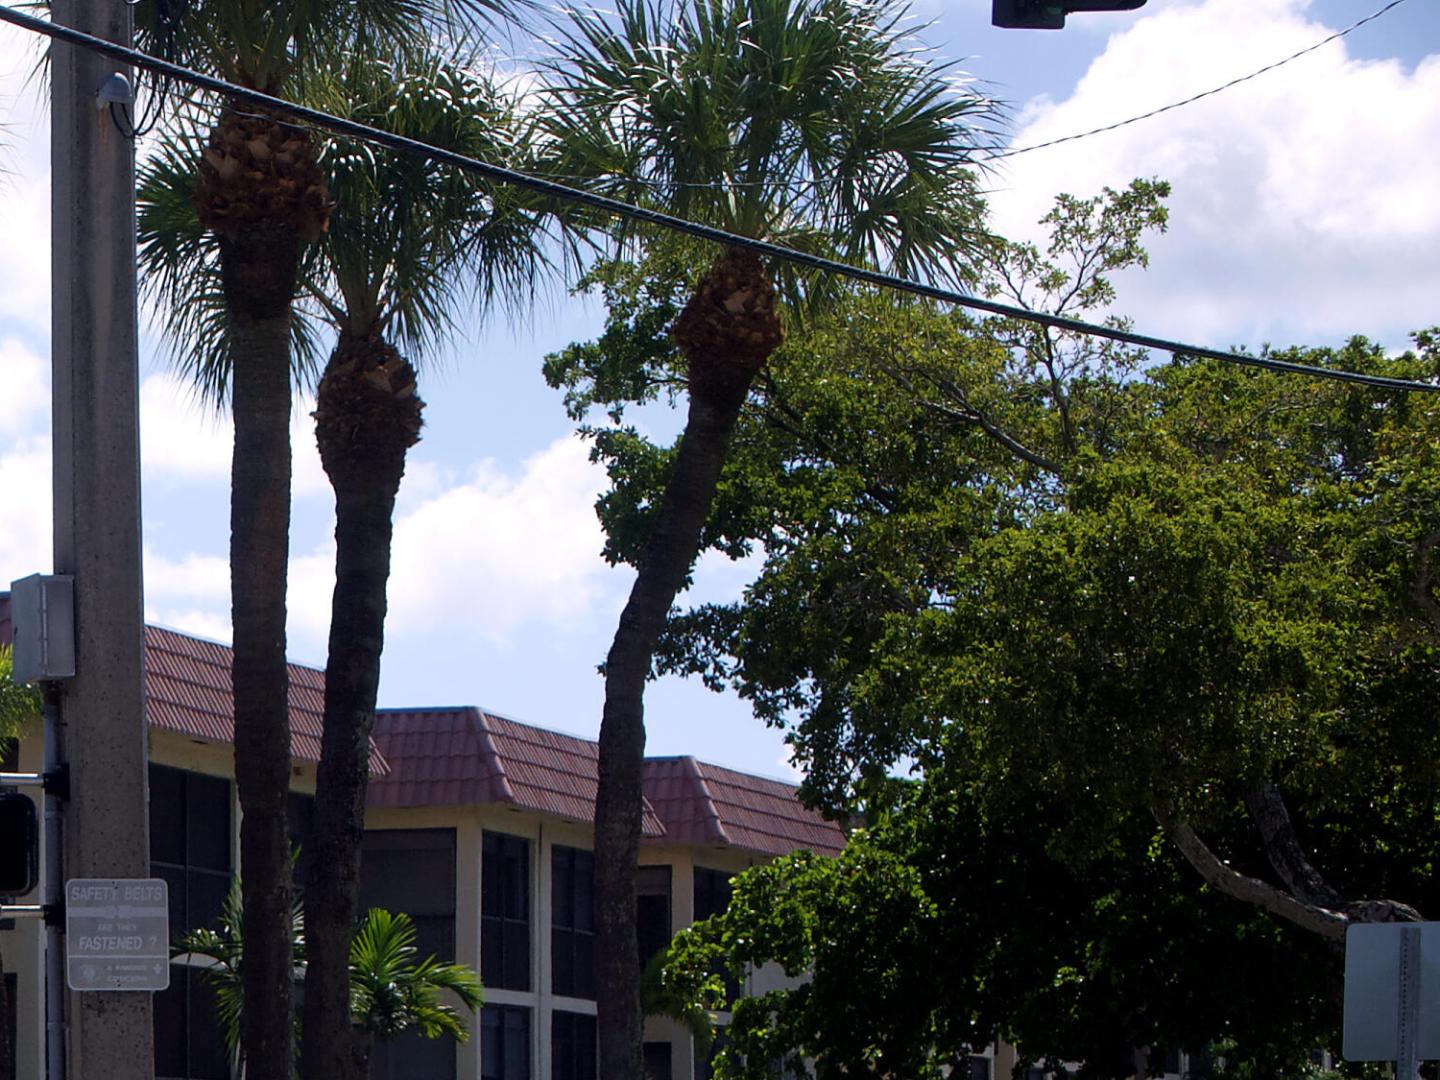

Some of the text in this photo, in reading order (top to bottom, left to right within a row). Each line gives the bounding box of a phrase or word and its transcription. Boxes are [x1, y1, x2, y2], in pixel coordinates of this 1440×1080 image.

[71, 886, 163, 901] SAFETY BELTS
[79, 936, 143, 951] FASTENED
